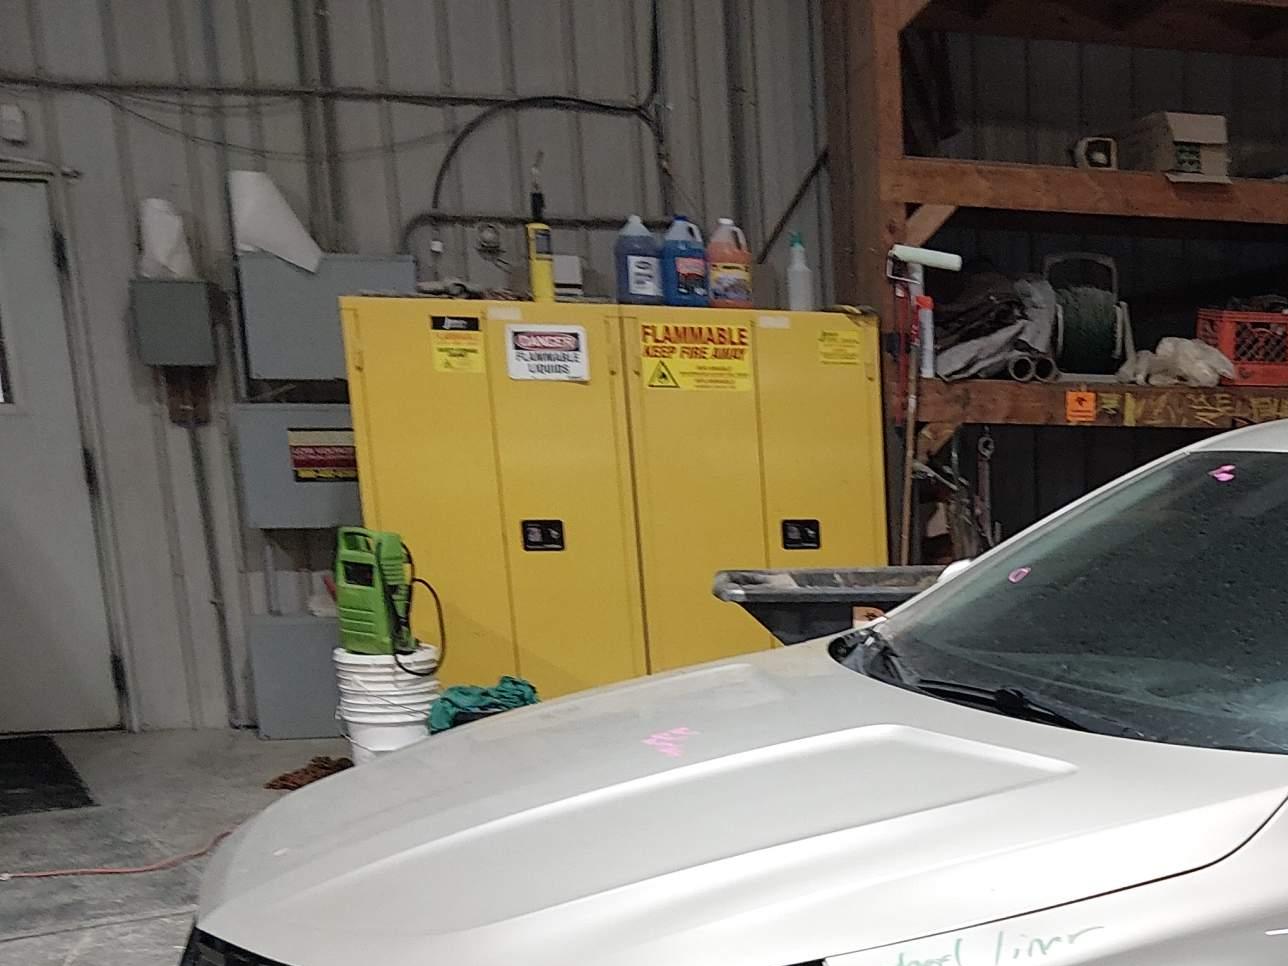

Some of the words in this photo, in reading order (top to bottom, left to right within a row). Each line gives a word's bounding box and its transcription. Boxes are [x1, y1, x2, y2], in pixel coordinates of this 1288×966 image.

[517, 334, 577, 349] DANGER
[641, 325, 748, 346] FLAMMABLE
[516, 352, 581, 364] FLAMMABLE
[643, 345, 677, 359] KEEP
[680, 346, 707, 360] FIRE
[711, 347, 746, 361] AWAY
